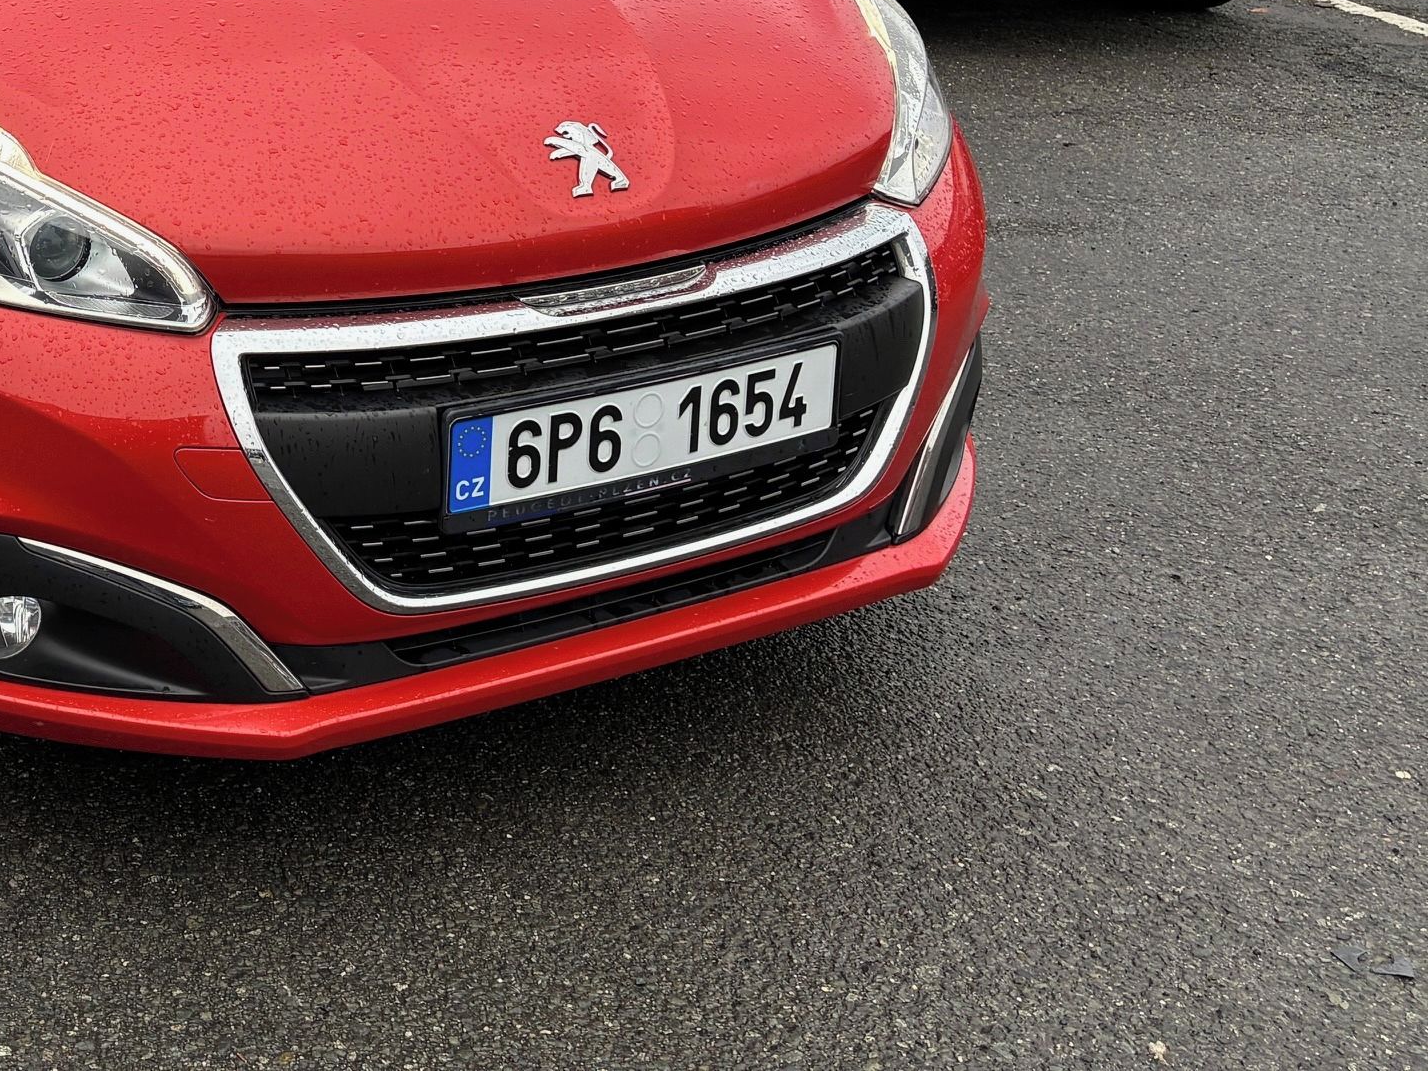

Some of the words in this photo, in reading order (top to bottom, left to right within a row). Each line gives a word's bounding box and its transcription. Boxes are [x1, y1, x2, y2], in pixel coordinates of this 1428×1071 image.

[507, 404, 623, 489] 6P6
[678, 361, 807, 454] 1654
[455, 476, 485, 501] CZ
